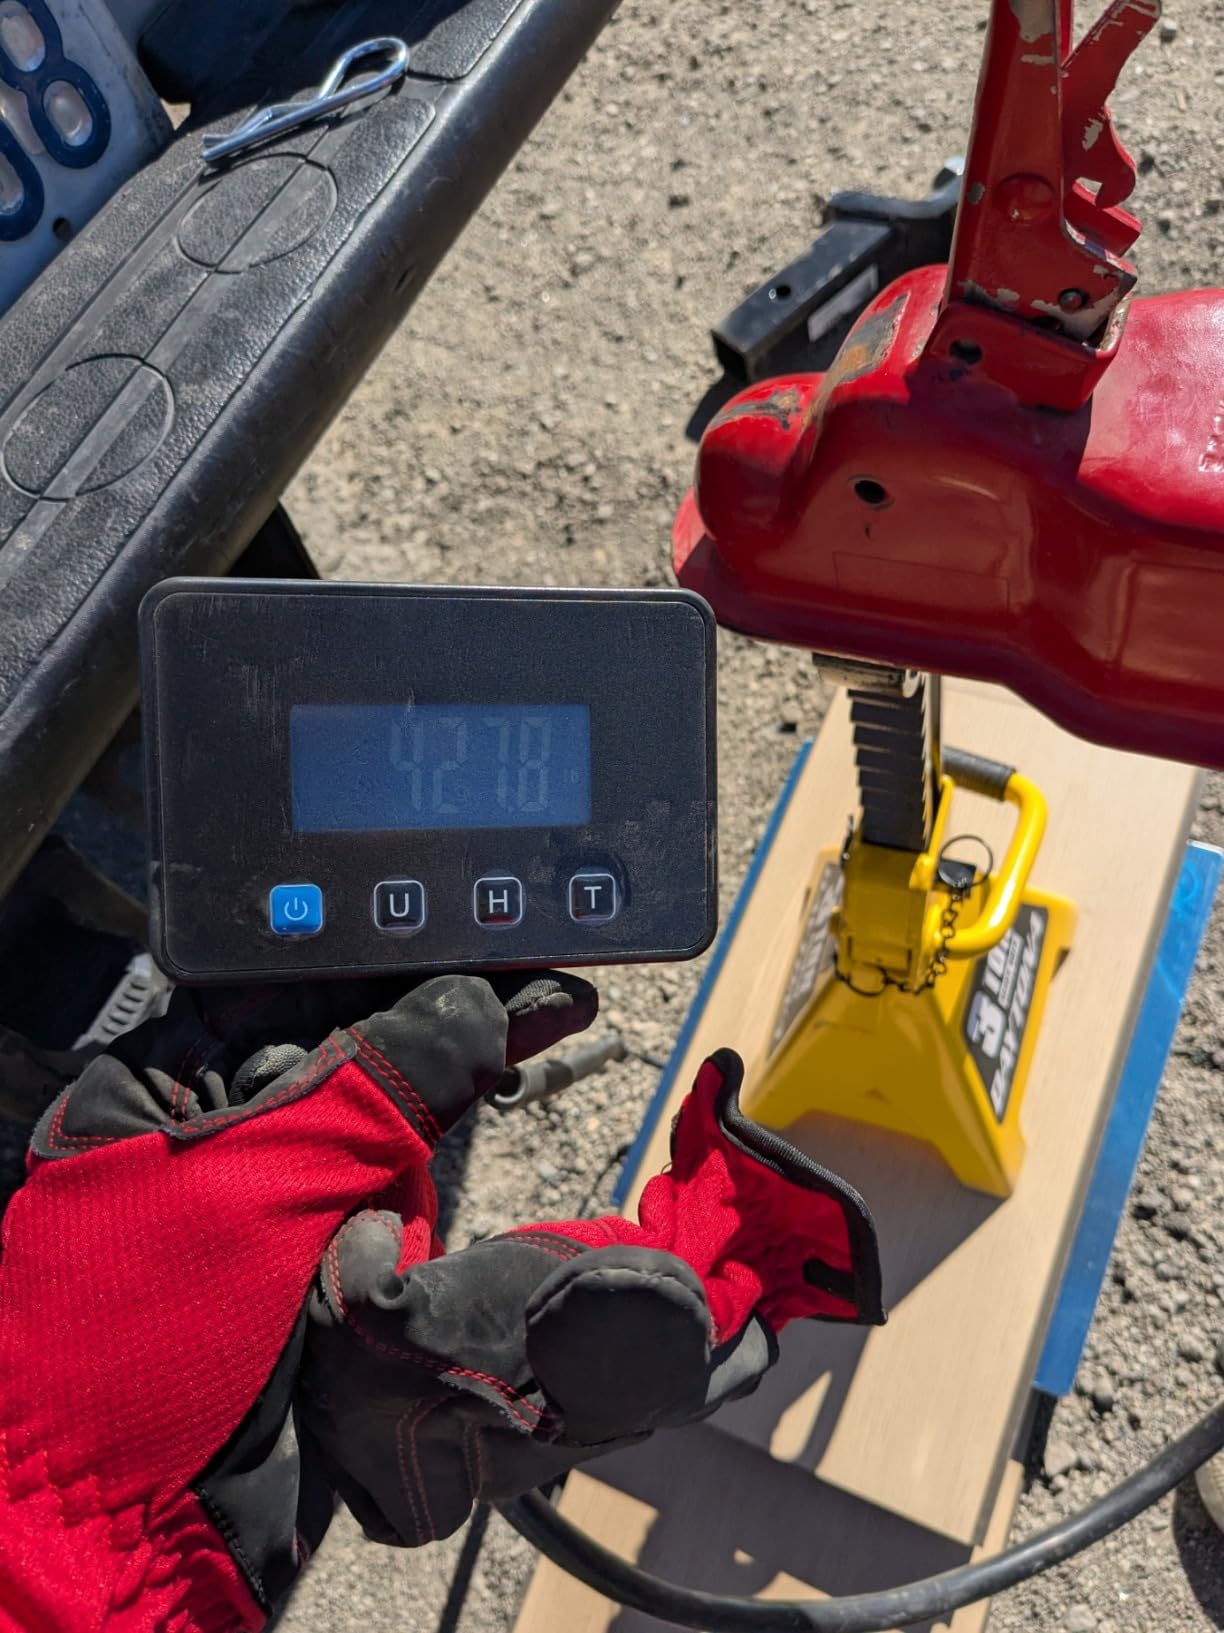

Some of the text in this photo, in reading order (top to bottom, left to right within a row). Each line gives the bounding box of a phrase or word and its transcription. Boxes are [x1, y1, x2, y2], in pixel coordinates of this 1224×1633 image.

[389, 893, 410, 918] U
[488, 890, 508, 914] H
[583, 886, 602, 909] T
[967, 991, 1002, 1059] 3
[988, 910, 1045, 1122] DAYTONA
